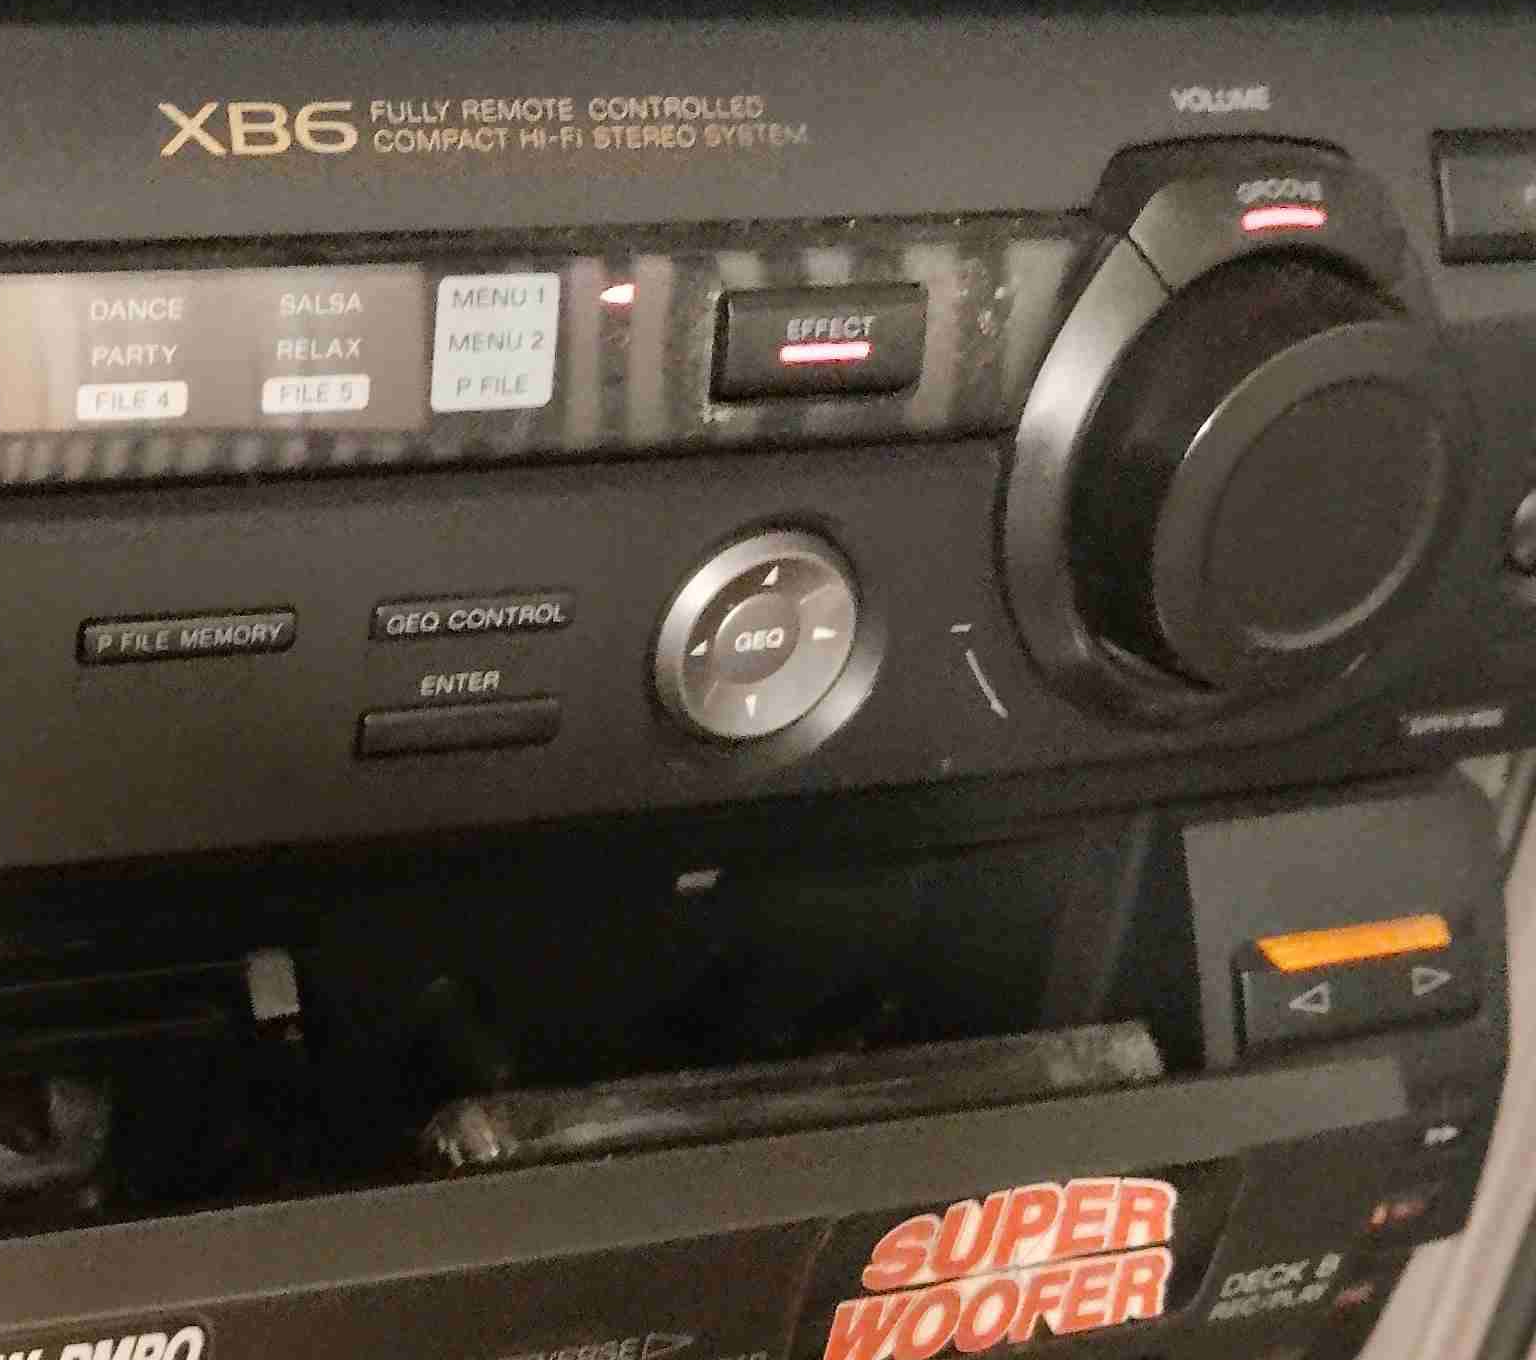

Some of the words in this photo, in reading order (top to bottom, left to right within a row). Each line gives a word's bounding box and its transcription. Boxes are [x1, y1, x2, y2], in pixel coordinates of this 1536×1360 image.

[370, 99, 450, 125] FULLY
[462, 98, 573, 123] REMOTE
[588, 95, 763, 122] CONTROLLED
[1171, 86, 1269, 113] VOLUME
[159, 101, 358, 158] XB6
[373, 127, 509, 154] COMPACT
[593, 124, 696, 150] STEREO
[704, 122, 810, 148] SYSTEM
[90, 297, 183, 322] DANCE
[280, 292, 363, 318] SALSA
[452, 286, 526, 310] MENU
[535, 285, 546, 306] 1
[448, 330, 522, 353] MENU
[529, 329, 545, 350] 2
[788, 314, 877, 341] EFFECT
[91, 343, 177, 368] PARTY
[276, 337, 362, 362] RELAX
[280, 383, 332, 405] FILE
[339, 381, 353, 402] 5
[456, 377, 472, 398] P
[479, 374, 529, 396] FILE
[95, 390, 149, 412] FILE
[156, 388, 170, 409] 4
[447, 602, 565, 632] CONTROL
[97, 633, 113, 654] P
[120, 630, 169, 654] FILE
[180, 621, 284, 649] MEMORY
[420, 670, 501, 697] ENTER
[862, 1176, 1177, 1291] SUPER
[1220, 1259, 1310, 1298] DECK
